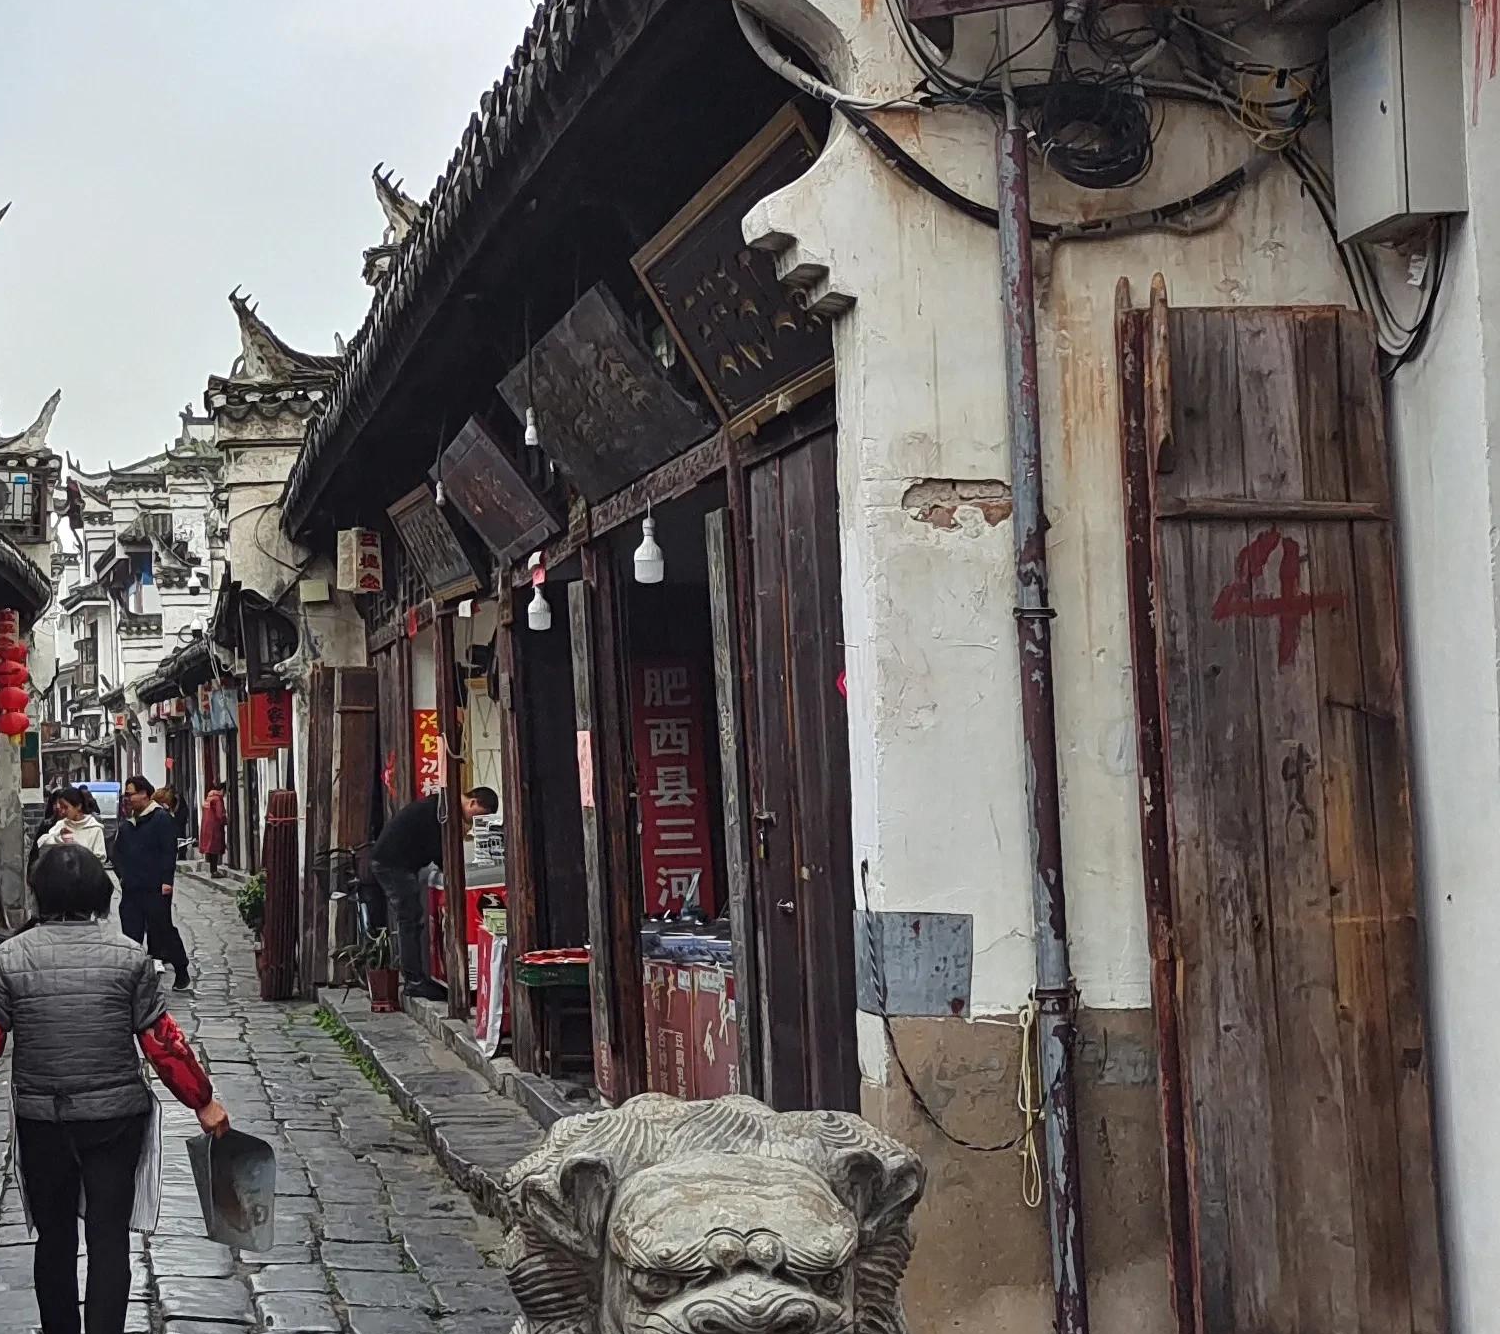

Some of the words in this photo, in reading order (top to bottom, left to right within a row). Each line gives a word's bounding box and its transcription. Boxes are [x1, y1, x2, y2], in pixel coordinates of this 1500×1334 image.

[1211, 524, 1347, 667] 4
[644, 669, 702, 907] 肥西县三河
